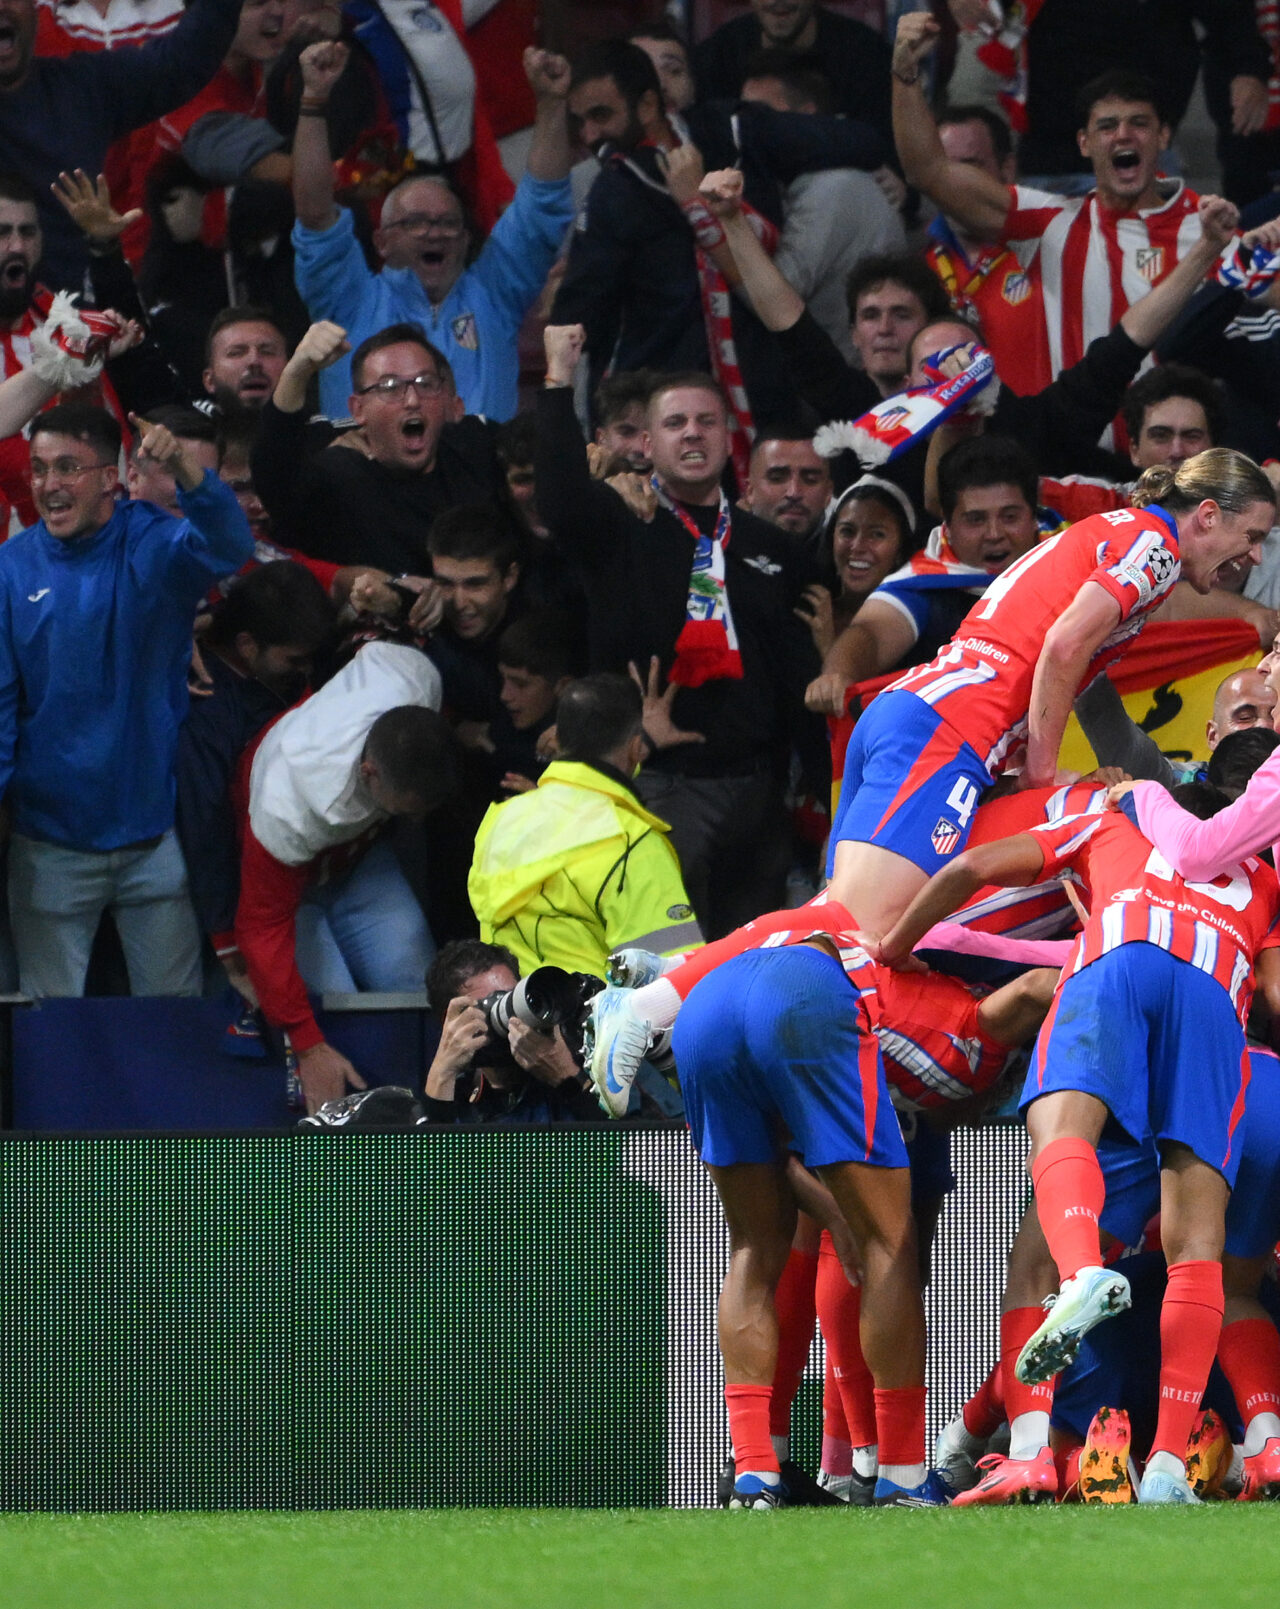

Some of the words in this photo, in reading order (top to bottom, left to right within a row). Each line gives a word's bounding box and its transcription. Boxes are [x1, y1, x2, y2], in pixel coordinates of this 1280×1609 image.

[964, 637, 1010, 664] Children
[946, 776, 977, 828] 4
[1144, 888, 1176, 908] Save
